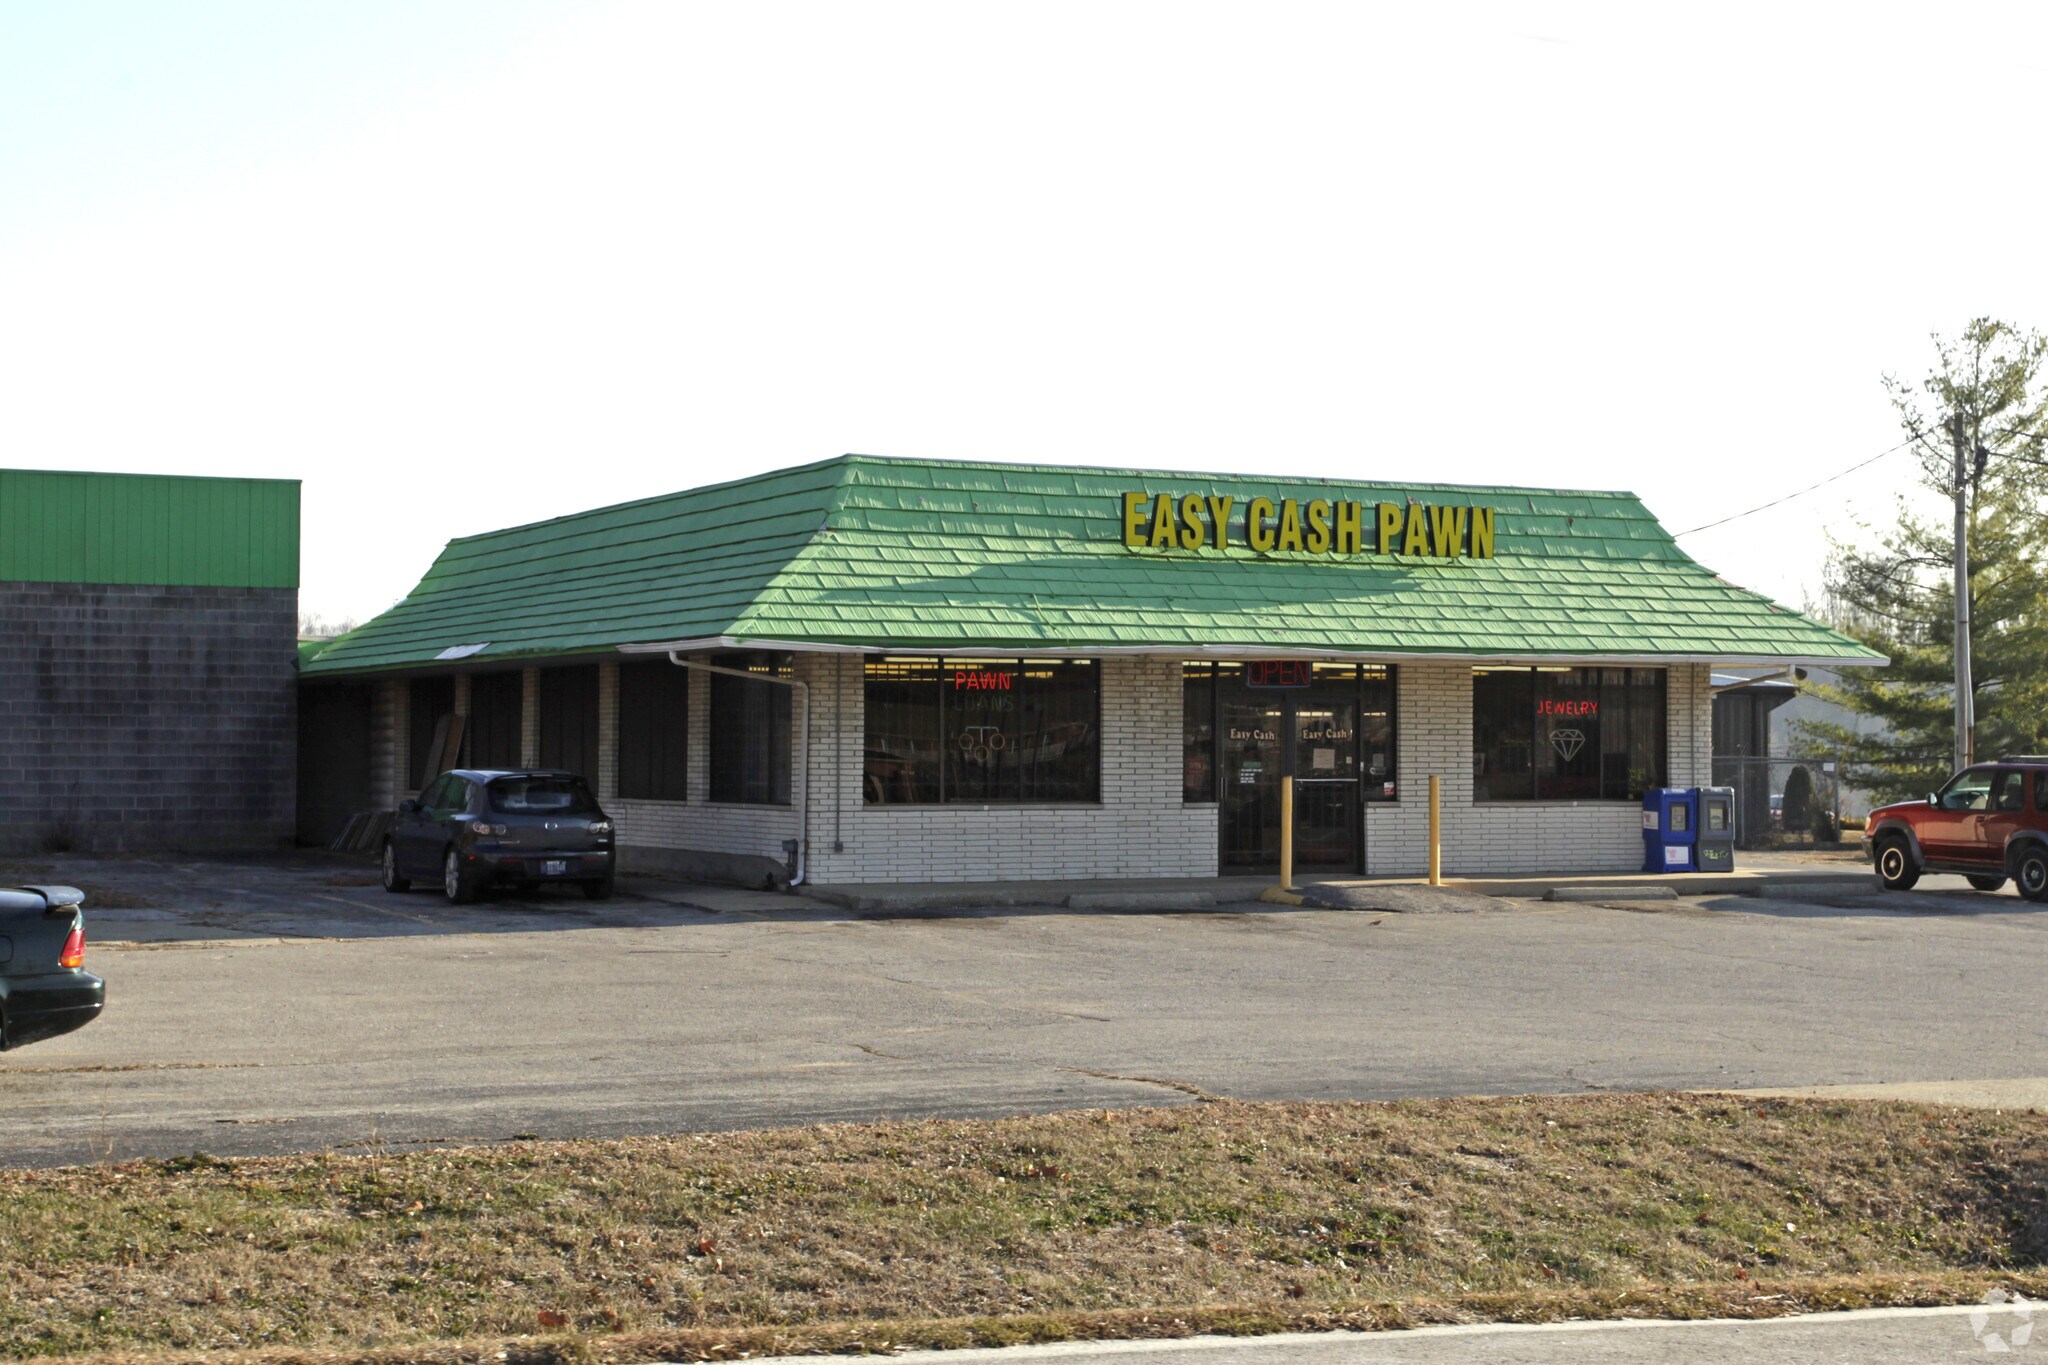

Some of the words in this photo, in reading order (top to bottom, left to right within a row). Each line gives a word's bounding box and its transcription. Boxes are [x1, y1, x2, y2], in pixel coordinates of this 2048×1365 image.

[1121, 492, 1233, 550] EASY
[1244, 497, 1362, 555] CASH
[1375, 503, 1494, 559] PAWN
[955, 671, 1011, 690] PAWN
[1251, 660, 1308, 685] OPEN
[955, 695, 1014, 712] LOANS
[1537, 700, 1598, 715] JEWELRY
[1230, 728, 1251, 741] Easy
[1253, 729, 1275, 740] Cash
[1302, 729, 1322, 740] Easy
[1326, 729, 1347, 739] Cash
